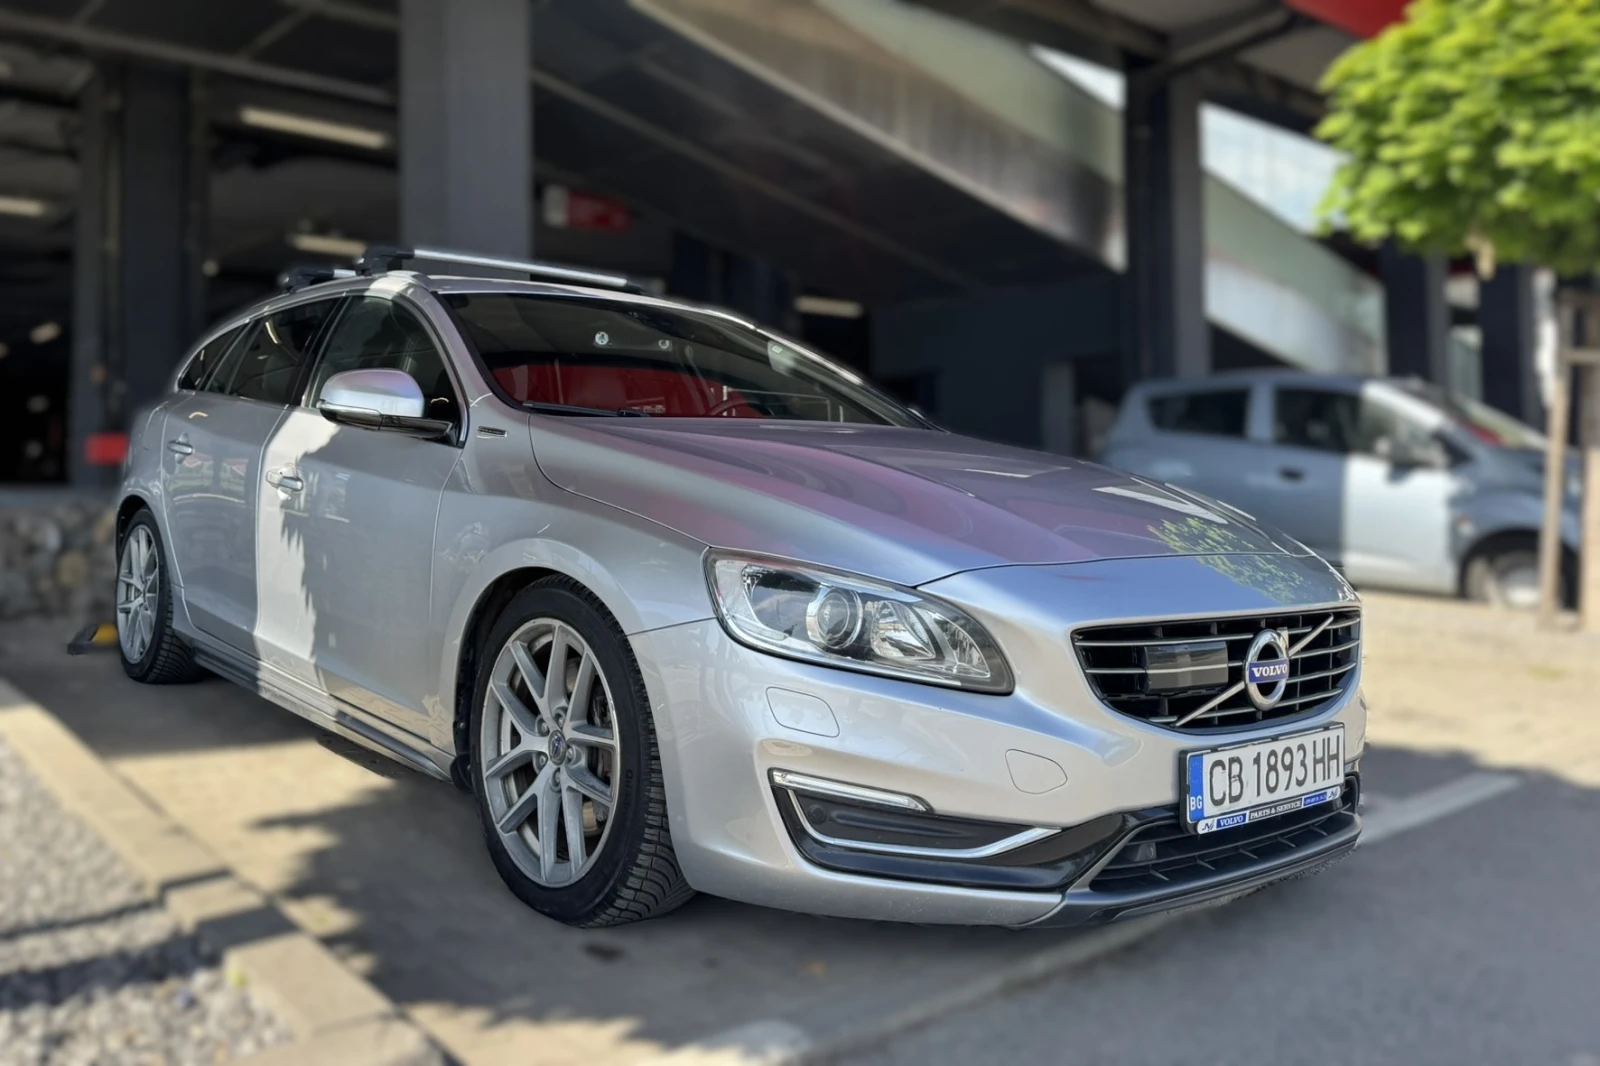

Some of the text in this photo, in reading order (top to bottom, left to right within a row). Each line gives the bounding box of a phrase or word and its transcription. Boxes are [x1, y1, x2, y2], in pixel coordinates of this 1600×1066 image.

[1251, 663, 1288, 678] VOLVO
[1209, 735, 1340, 807] CB 1893 HH
[1190, 795, 1203, 811] BG
[1219, 815, 1244, 828] VOLVO
[1249, 809, 1271, 820] PARTS
[1276, 801, 1302, 813] SERVICE
